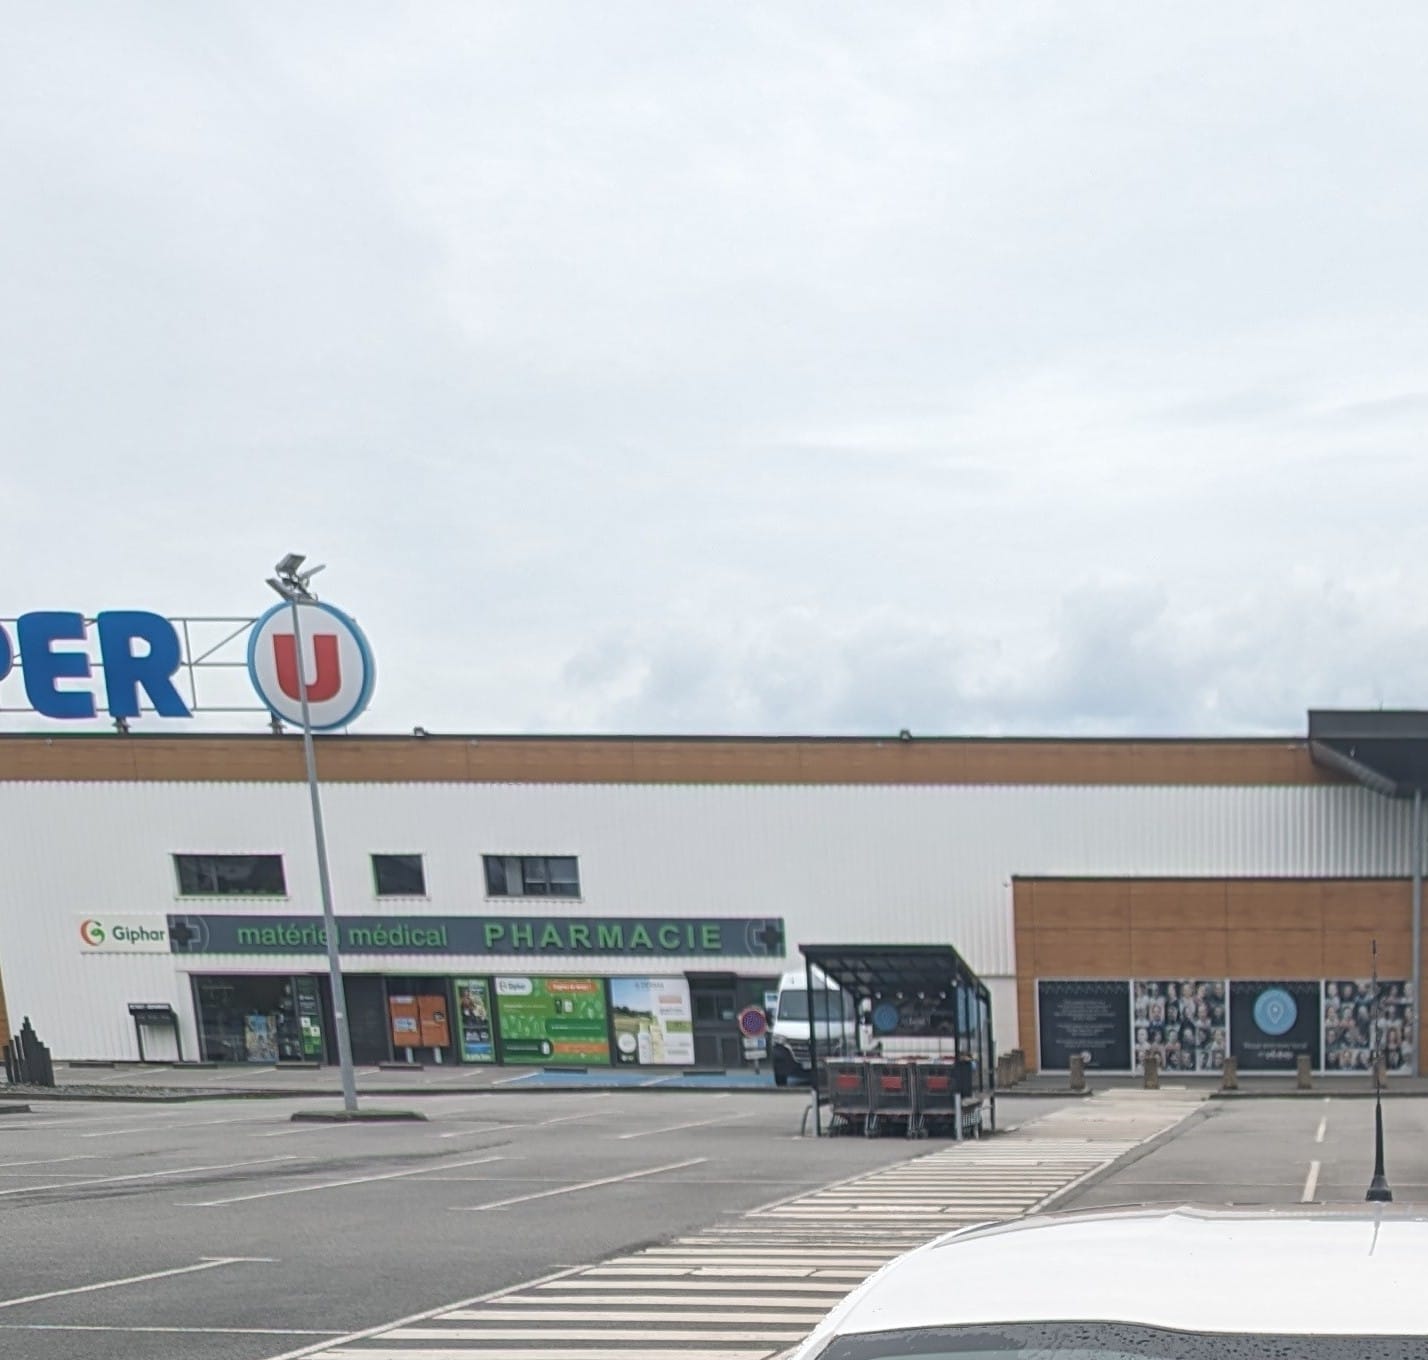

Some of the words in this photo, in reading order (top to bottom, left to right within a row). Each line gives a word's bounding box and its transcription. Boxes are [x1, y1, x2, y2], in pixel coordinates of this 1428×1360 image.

[0, 611, 194, 719] ER
[272, 634, 341, 702] U
[112, 926, 165, 943] Giphar
[348, 924, 448, 948] médical
[484, 924, 722, 949] PHARMACIE
